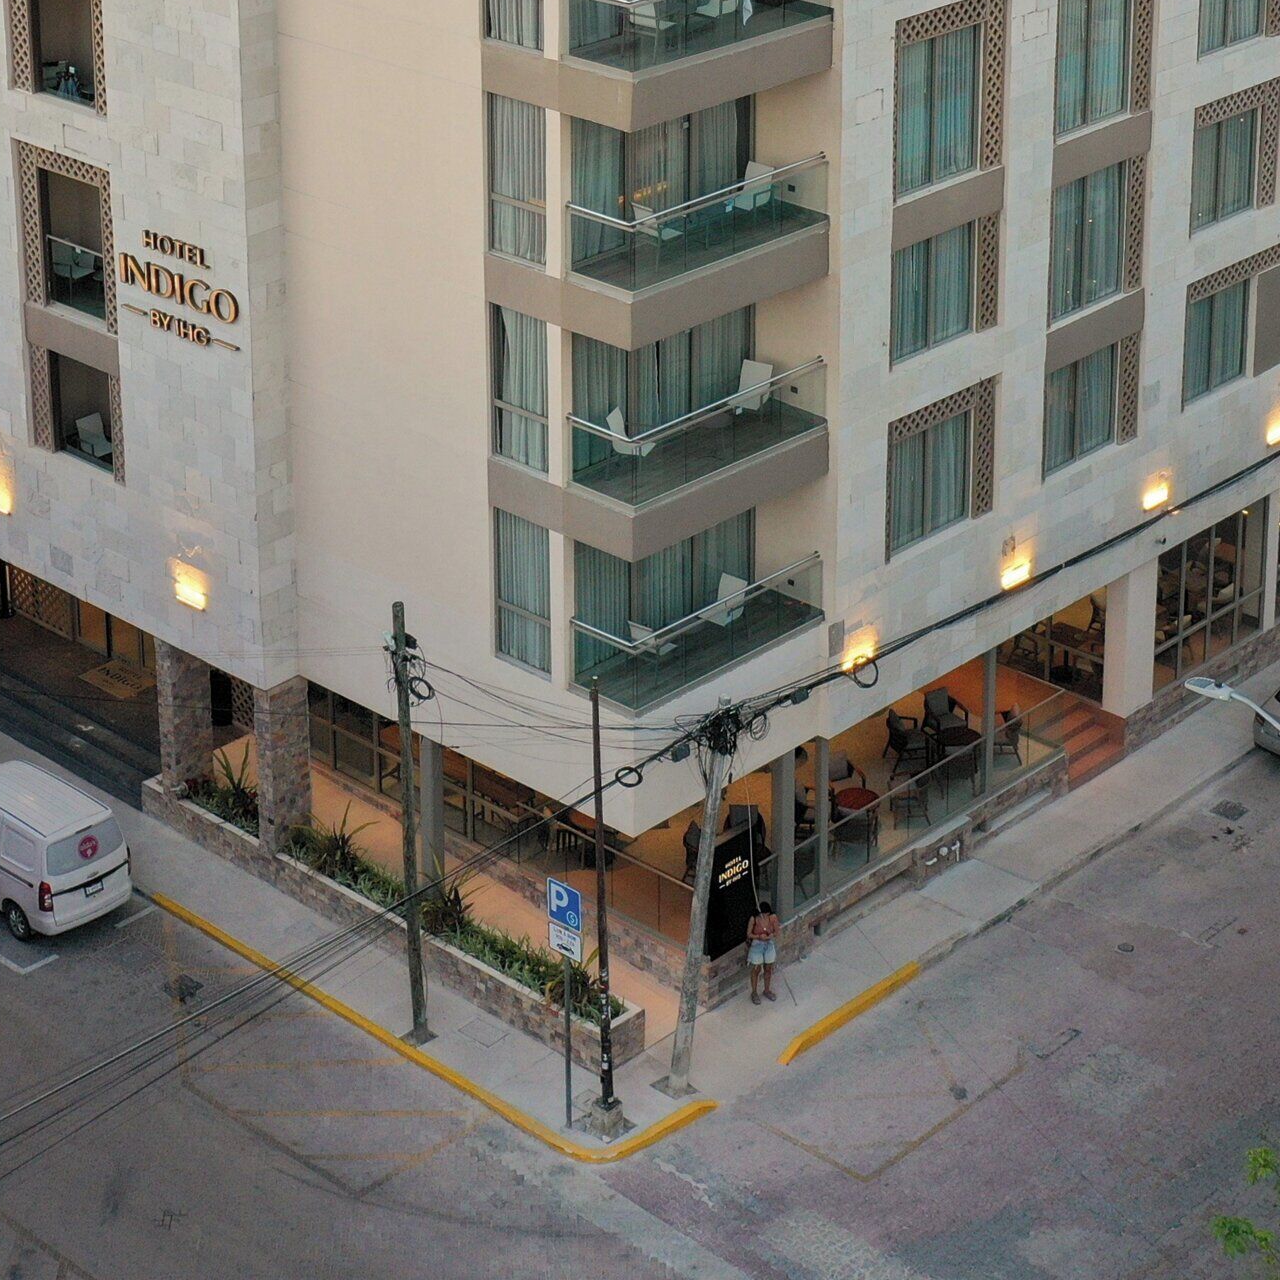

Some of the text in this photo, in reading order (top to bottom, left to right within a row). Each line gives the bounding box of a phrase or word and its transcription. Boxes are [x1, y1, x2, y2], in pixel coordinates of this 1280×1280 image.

[141, 229, 211, 269] HOTEL
[119, 252, 240, 324] INDIGO
[149, 308, 211, 347] BY IHG
[719, 860, 749, 883] INDIGO
[550, 881, 569, 912] P
